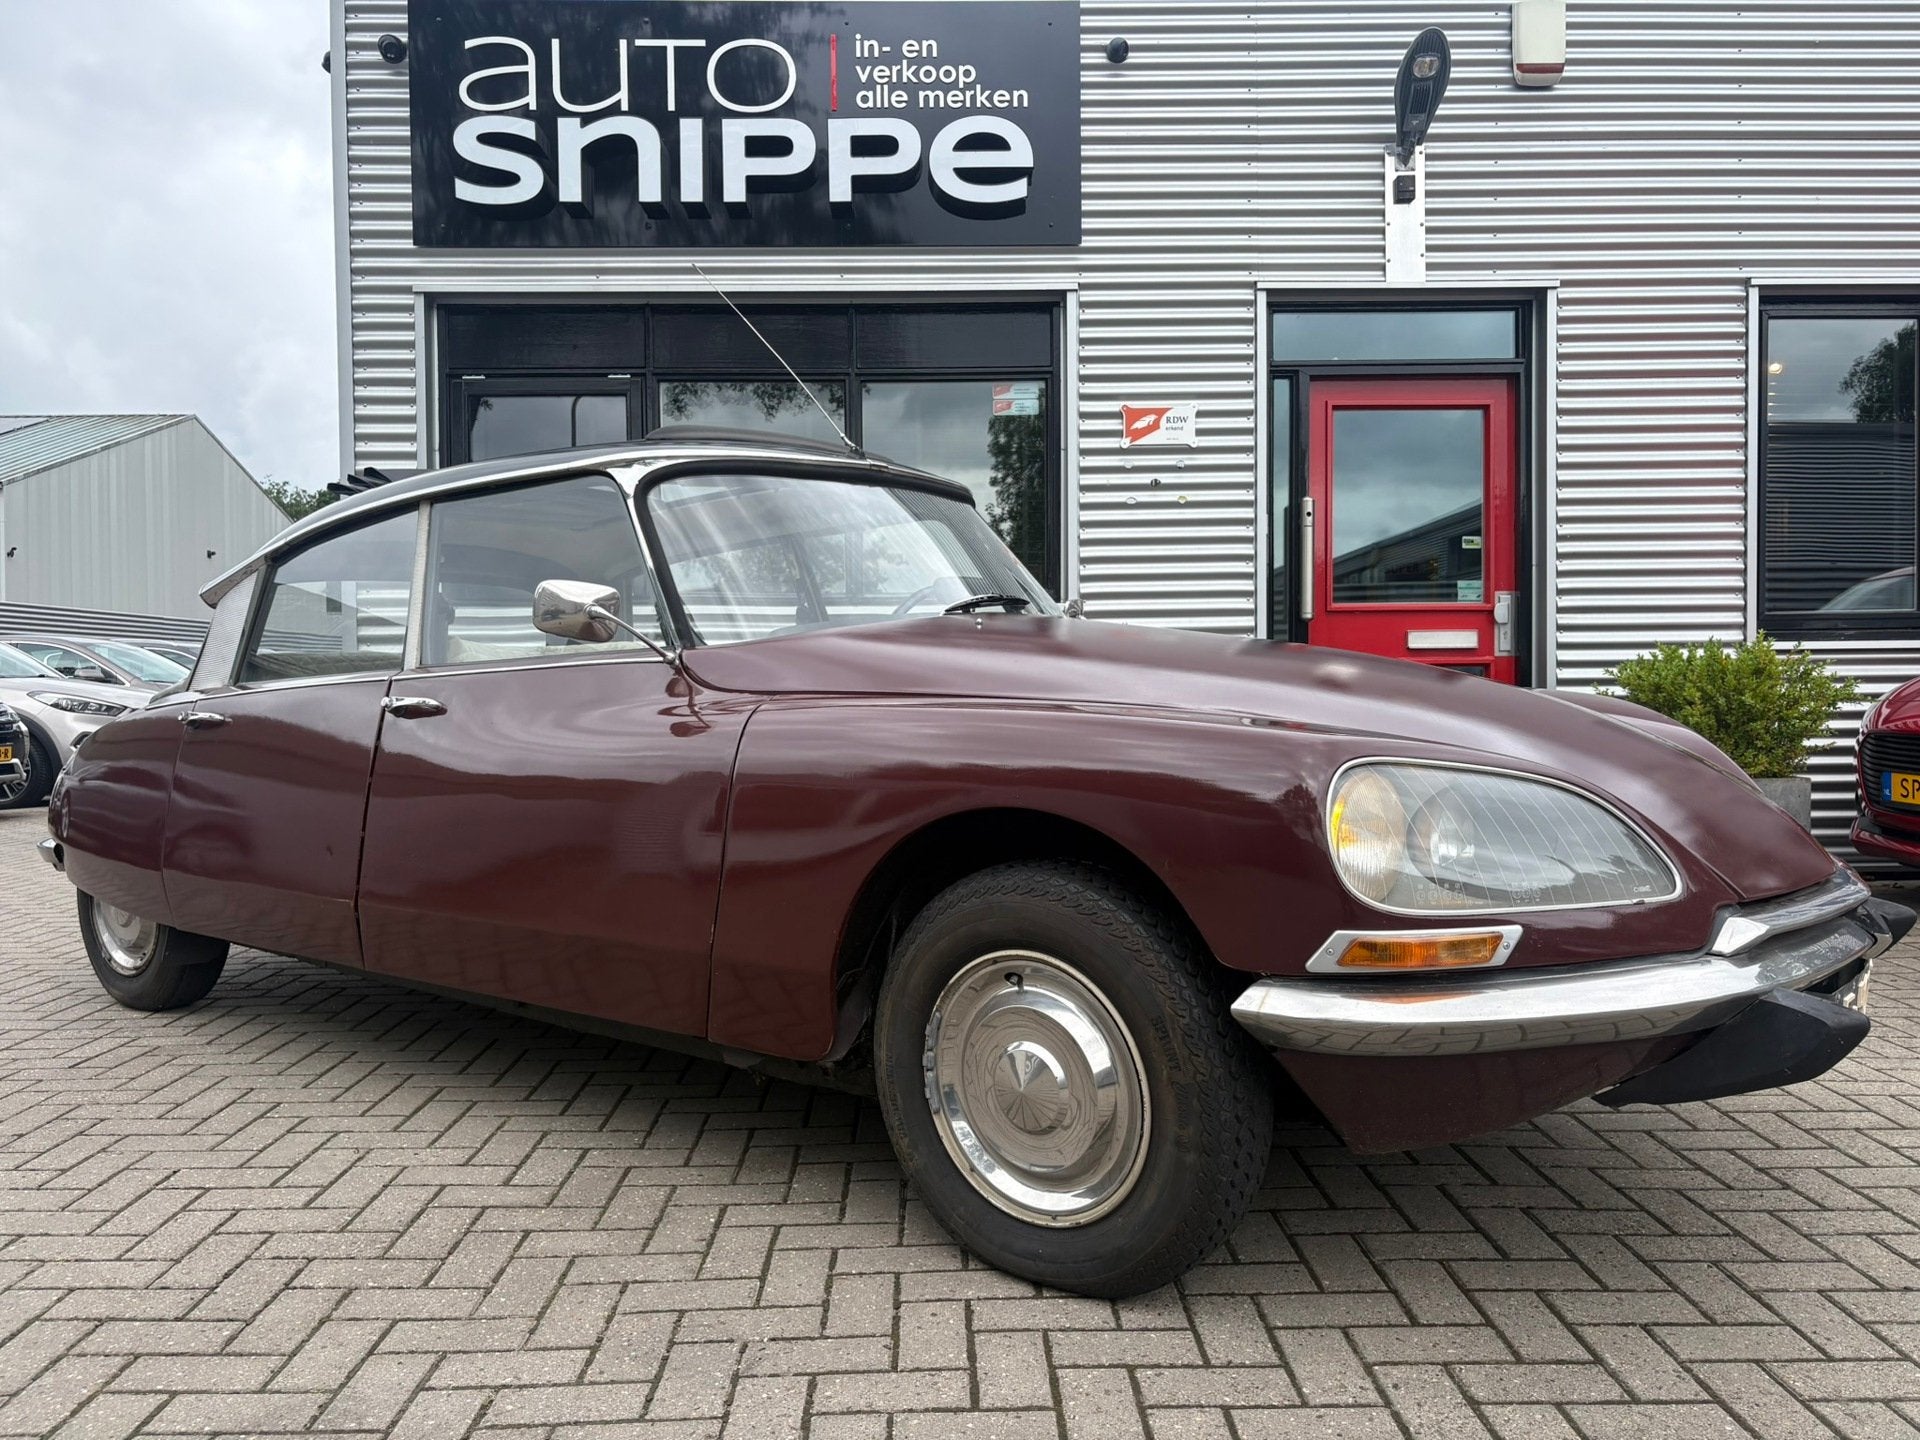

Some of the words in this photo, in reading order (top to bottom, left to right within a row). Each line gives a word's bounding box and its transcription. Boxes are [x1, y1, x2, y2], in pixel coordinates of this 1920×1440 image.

[855, 33, 891, 58] in-
[901, 38, 938, 58] en
[855, 59, 977, 89] verkoop
[855, 84, 909, 109] alle
[918, 84, 1029, 109] merken
[1165, 415, 1190, 424] RDW
